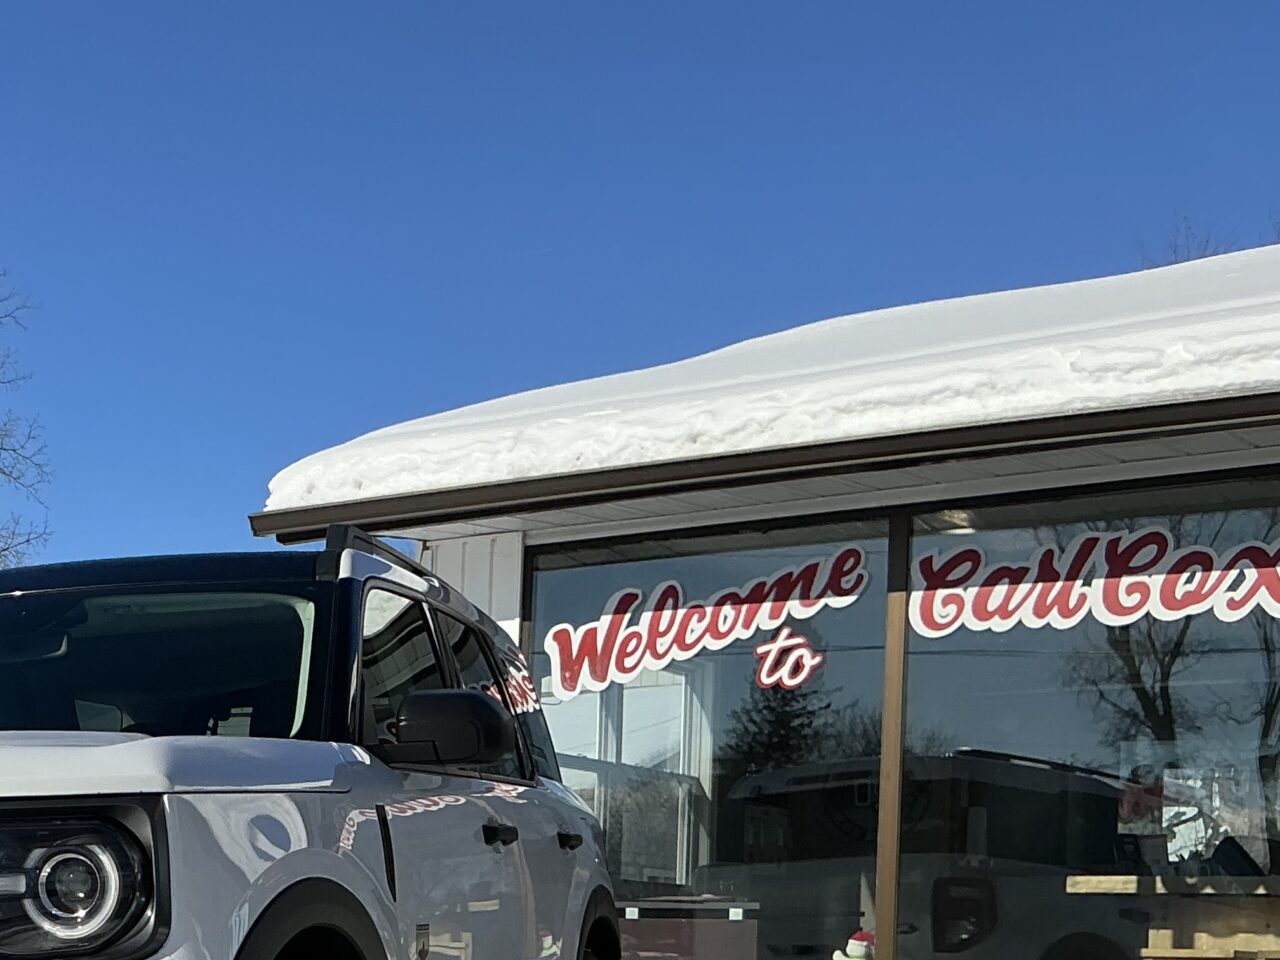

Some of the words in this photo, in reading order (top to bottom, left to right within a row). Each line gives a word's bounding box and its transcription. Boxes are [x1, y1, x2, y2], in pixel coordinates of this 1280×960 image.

[547, 546, 867, 697] Welcome
[911, 534, 1099, 635] Carl
[756, 627, 822, 690] to
